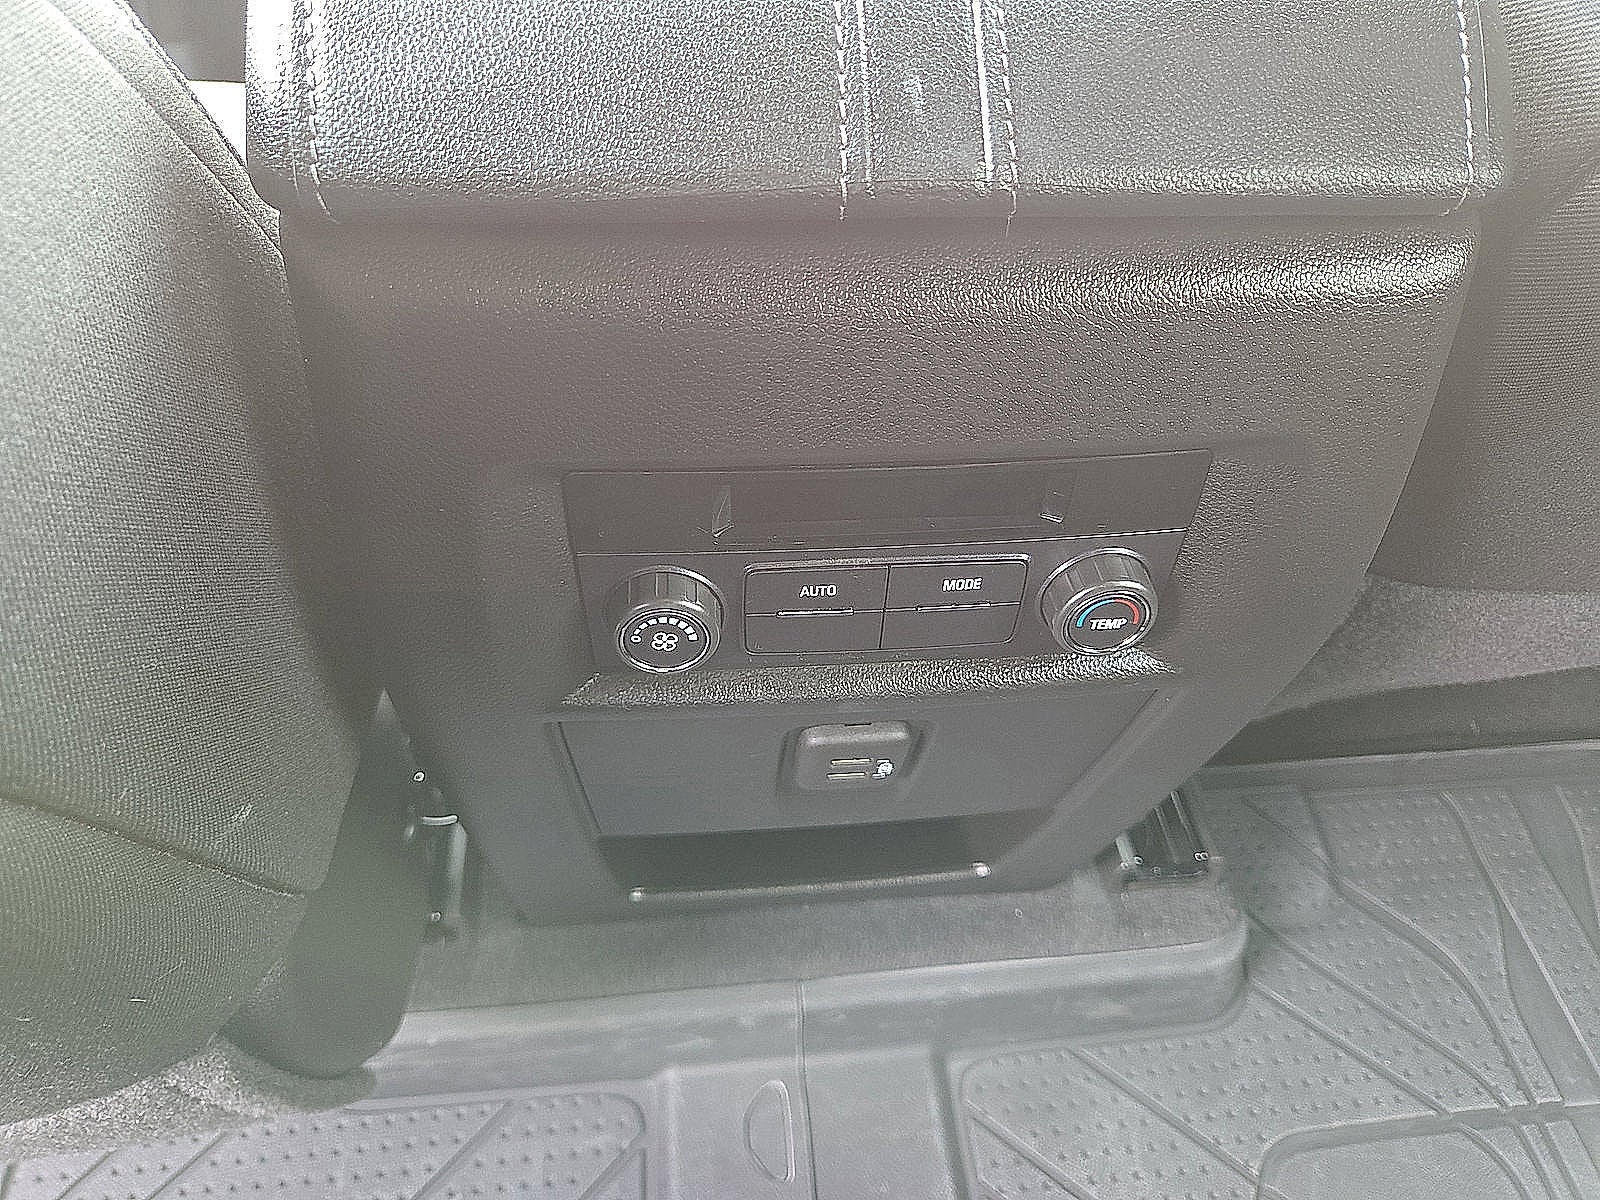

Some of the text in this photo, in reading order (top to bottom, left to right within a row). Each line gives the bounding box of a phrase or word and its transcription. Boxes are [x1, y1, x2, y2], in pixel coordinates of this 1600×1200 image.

[799, 584, 837, 598] AUTO
[942, 577, 983, 592] MODE
[1089, 617, 1128, 631] TEMP
